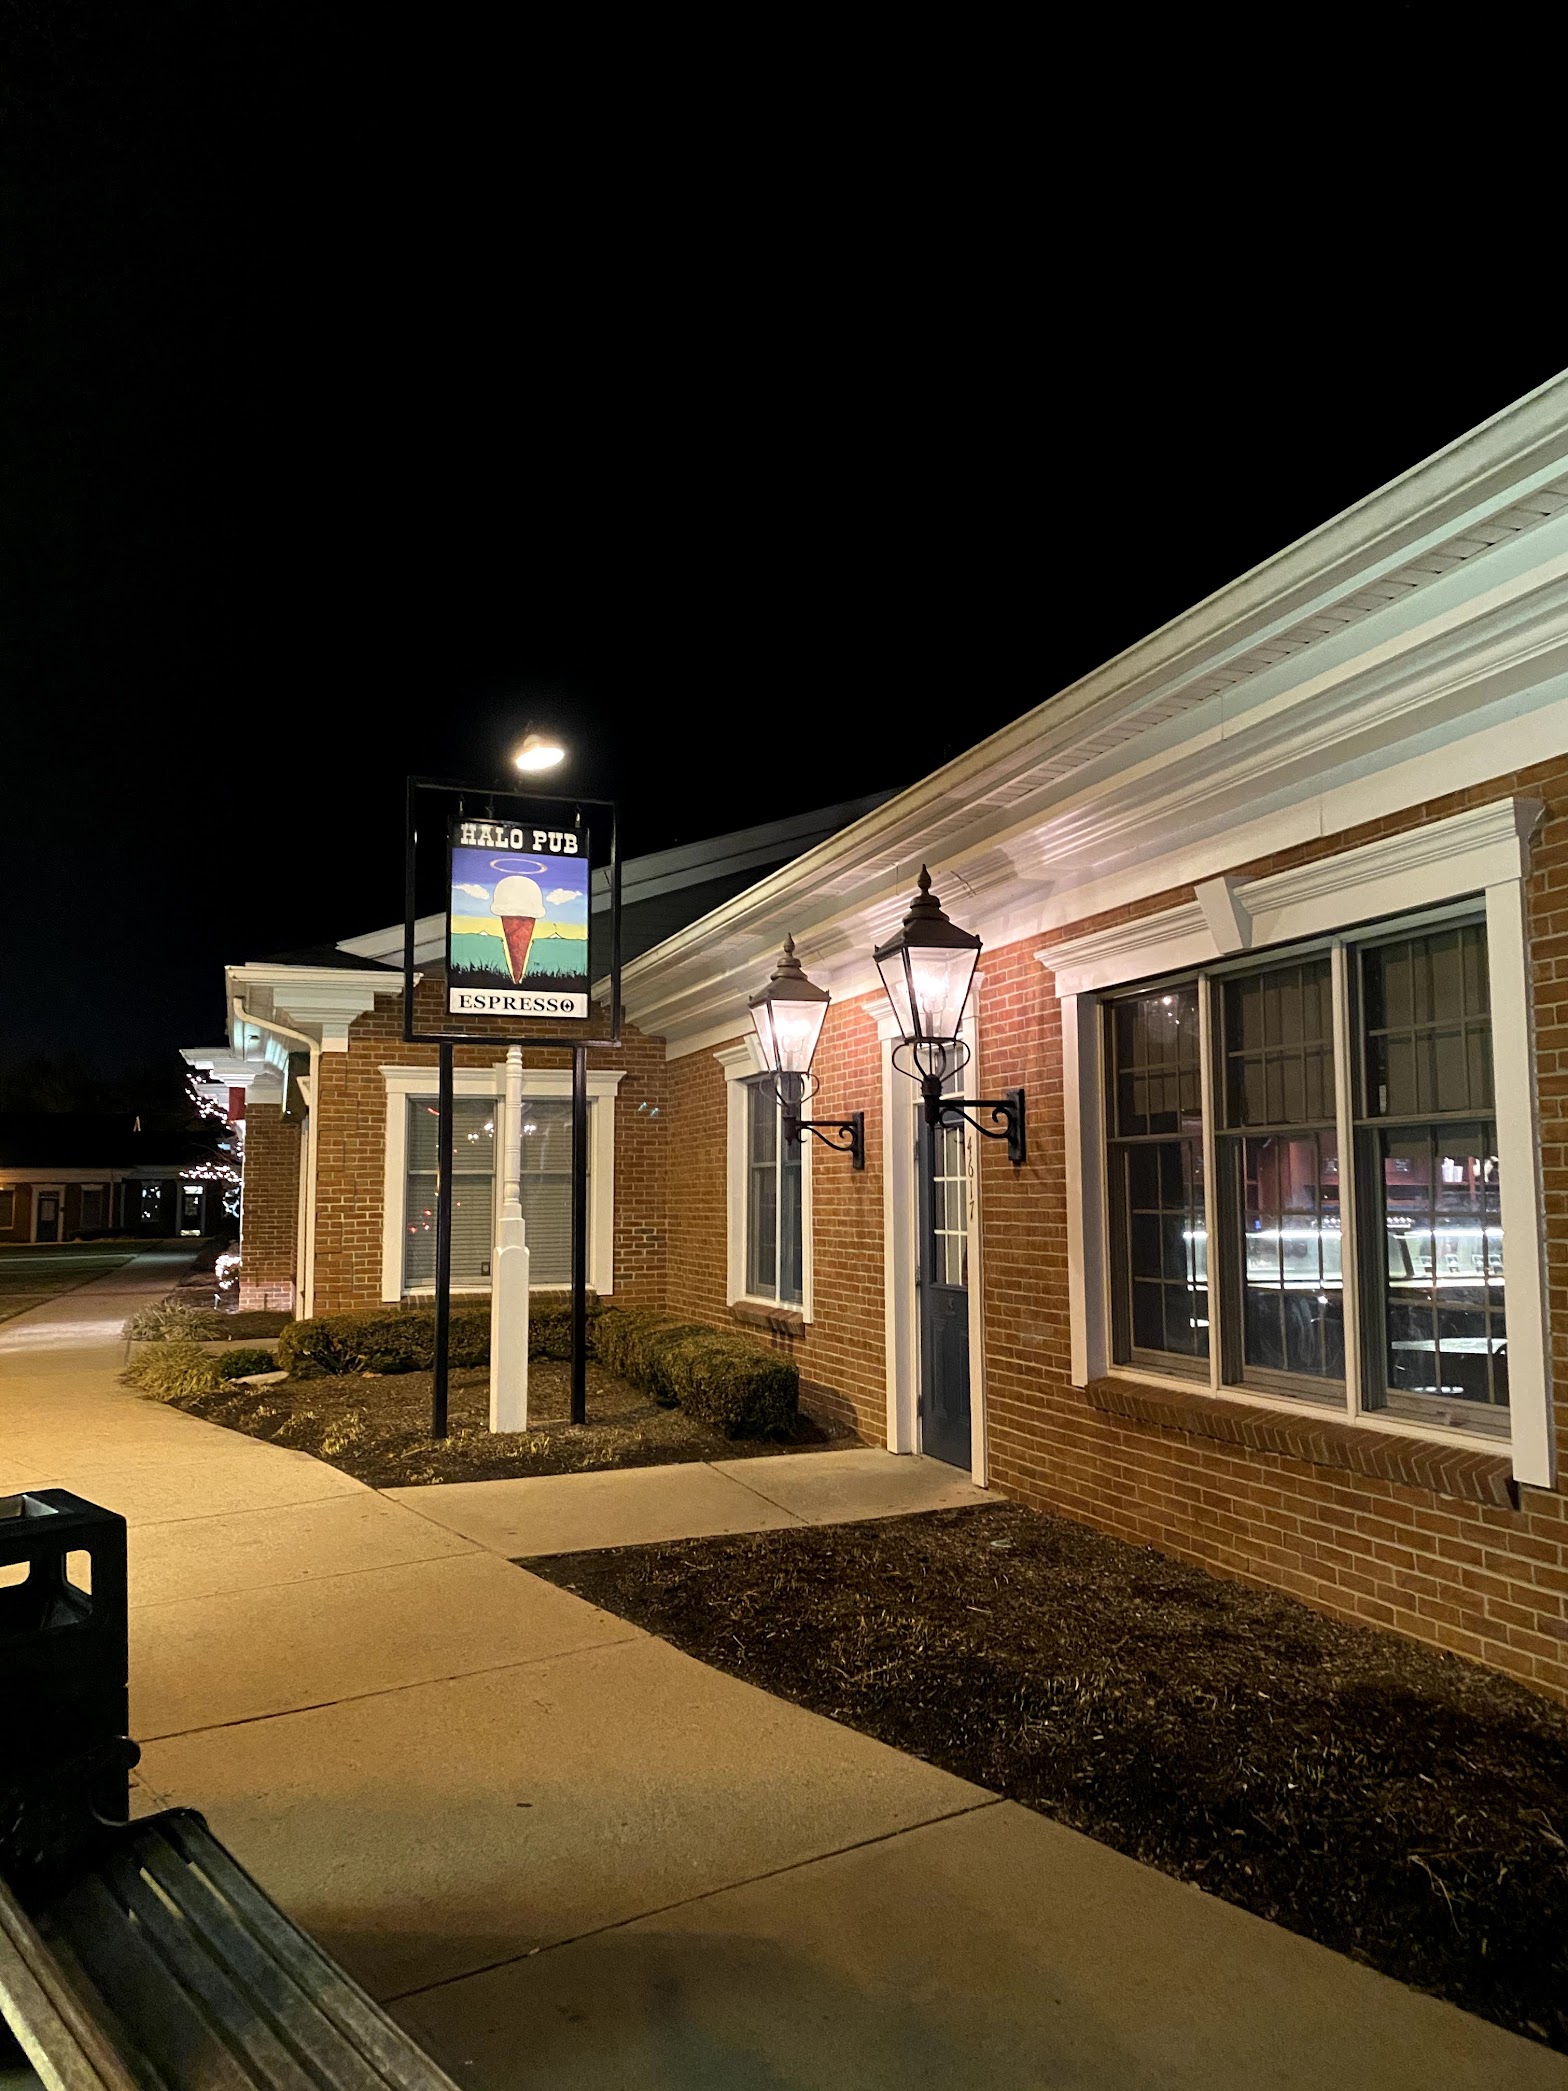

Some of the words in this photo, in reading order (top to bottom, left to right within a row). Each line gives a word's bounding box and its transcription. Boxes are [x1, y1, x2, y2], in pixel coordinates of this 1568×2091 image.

[460, 822, 524, 850] HALO
[532, 830, 579, 854] PUB
[458, 994, 575, 1013] ESPRESSO
